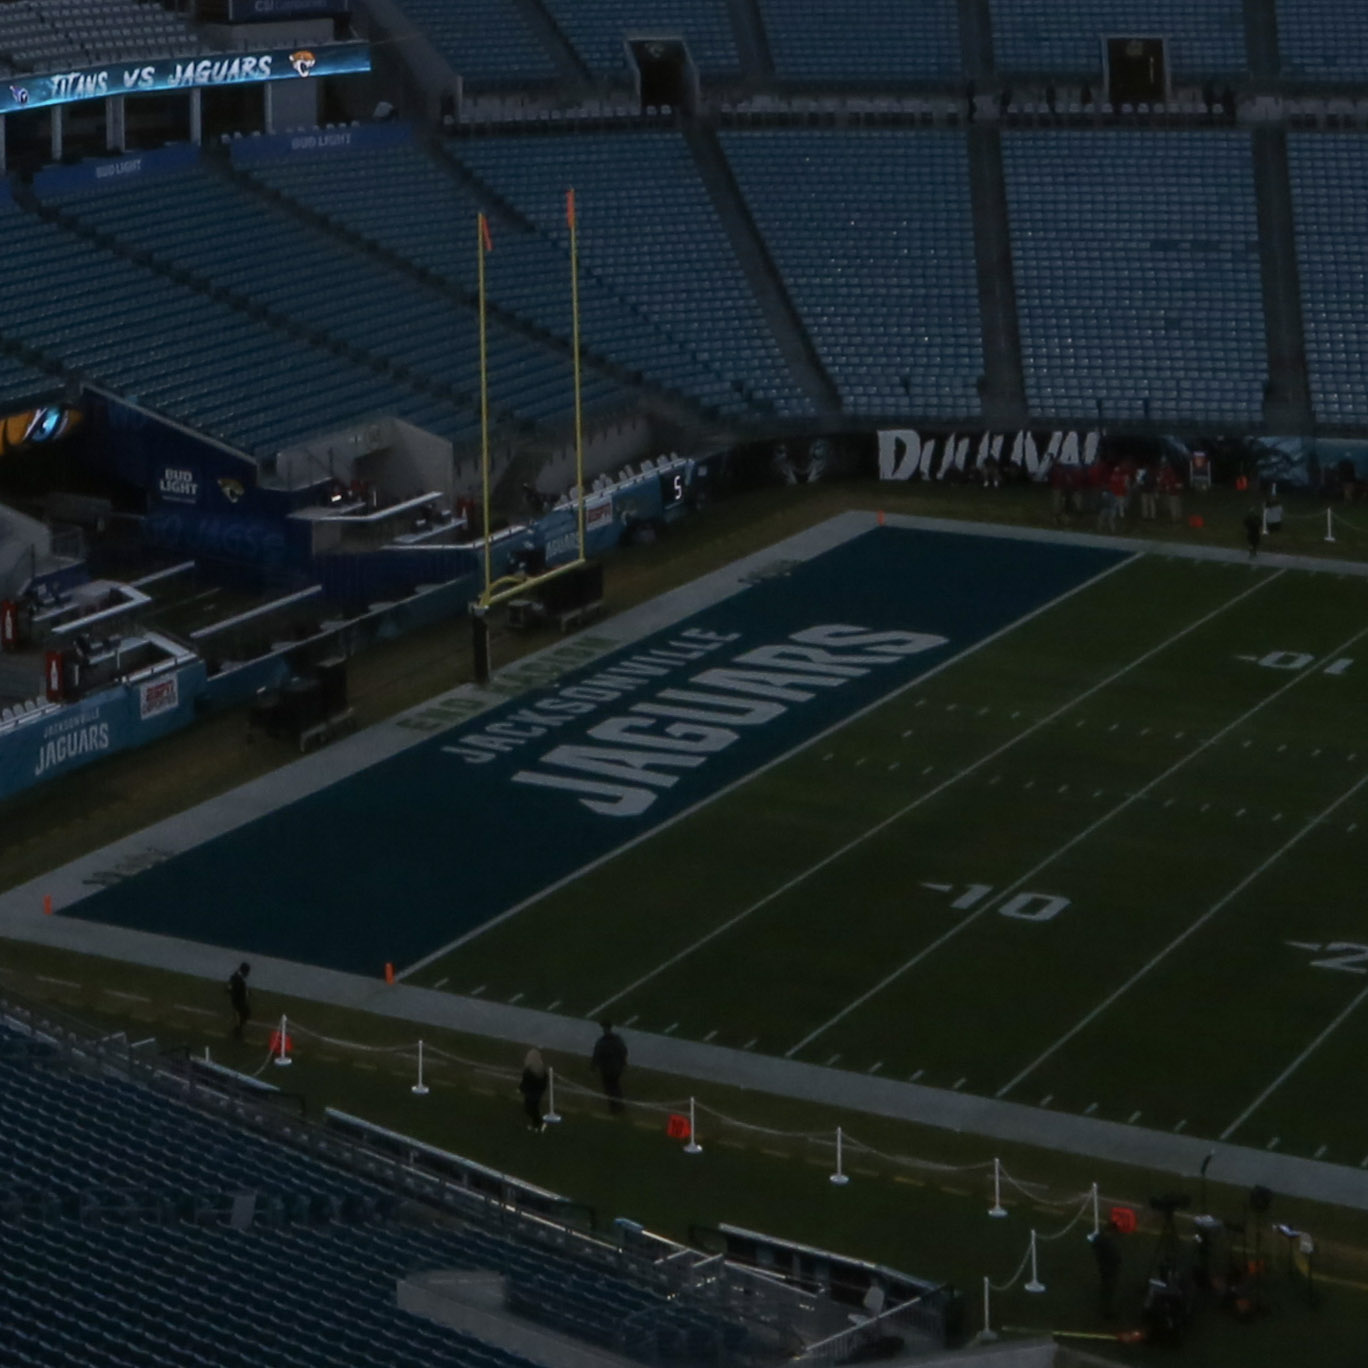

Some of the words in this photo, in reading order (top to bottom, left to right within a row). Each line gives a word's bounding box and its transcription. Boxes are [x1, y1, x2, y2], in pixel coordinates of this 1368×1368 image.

[50, 71, 108, 101] TITANS
[123, 66, 155, 91] VS
[168, 56, 272, 87] JAGUARS
[292, 138, 315, 149] BUD
[318, 134, 351, 148] LIGHT
[96, 165, 114, 178] BUD
[116, 159, 142, 174] LIGHT
[159, 480, 198, 495] LIGHT
[165, 468, 192, 482] BUD
[673, 475, 682, 500] 5
[441, 627, 743, 764] JACKSONVILLE
[510, 623, 951, 817] JAGUARS
[35, 722, 109, 777] JAGUARS
[951, 883, 1072, 922] 10
